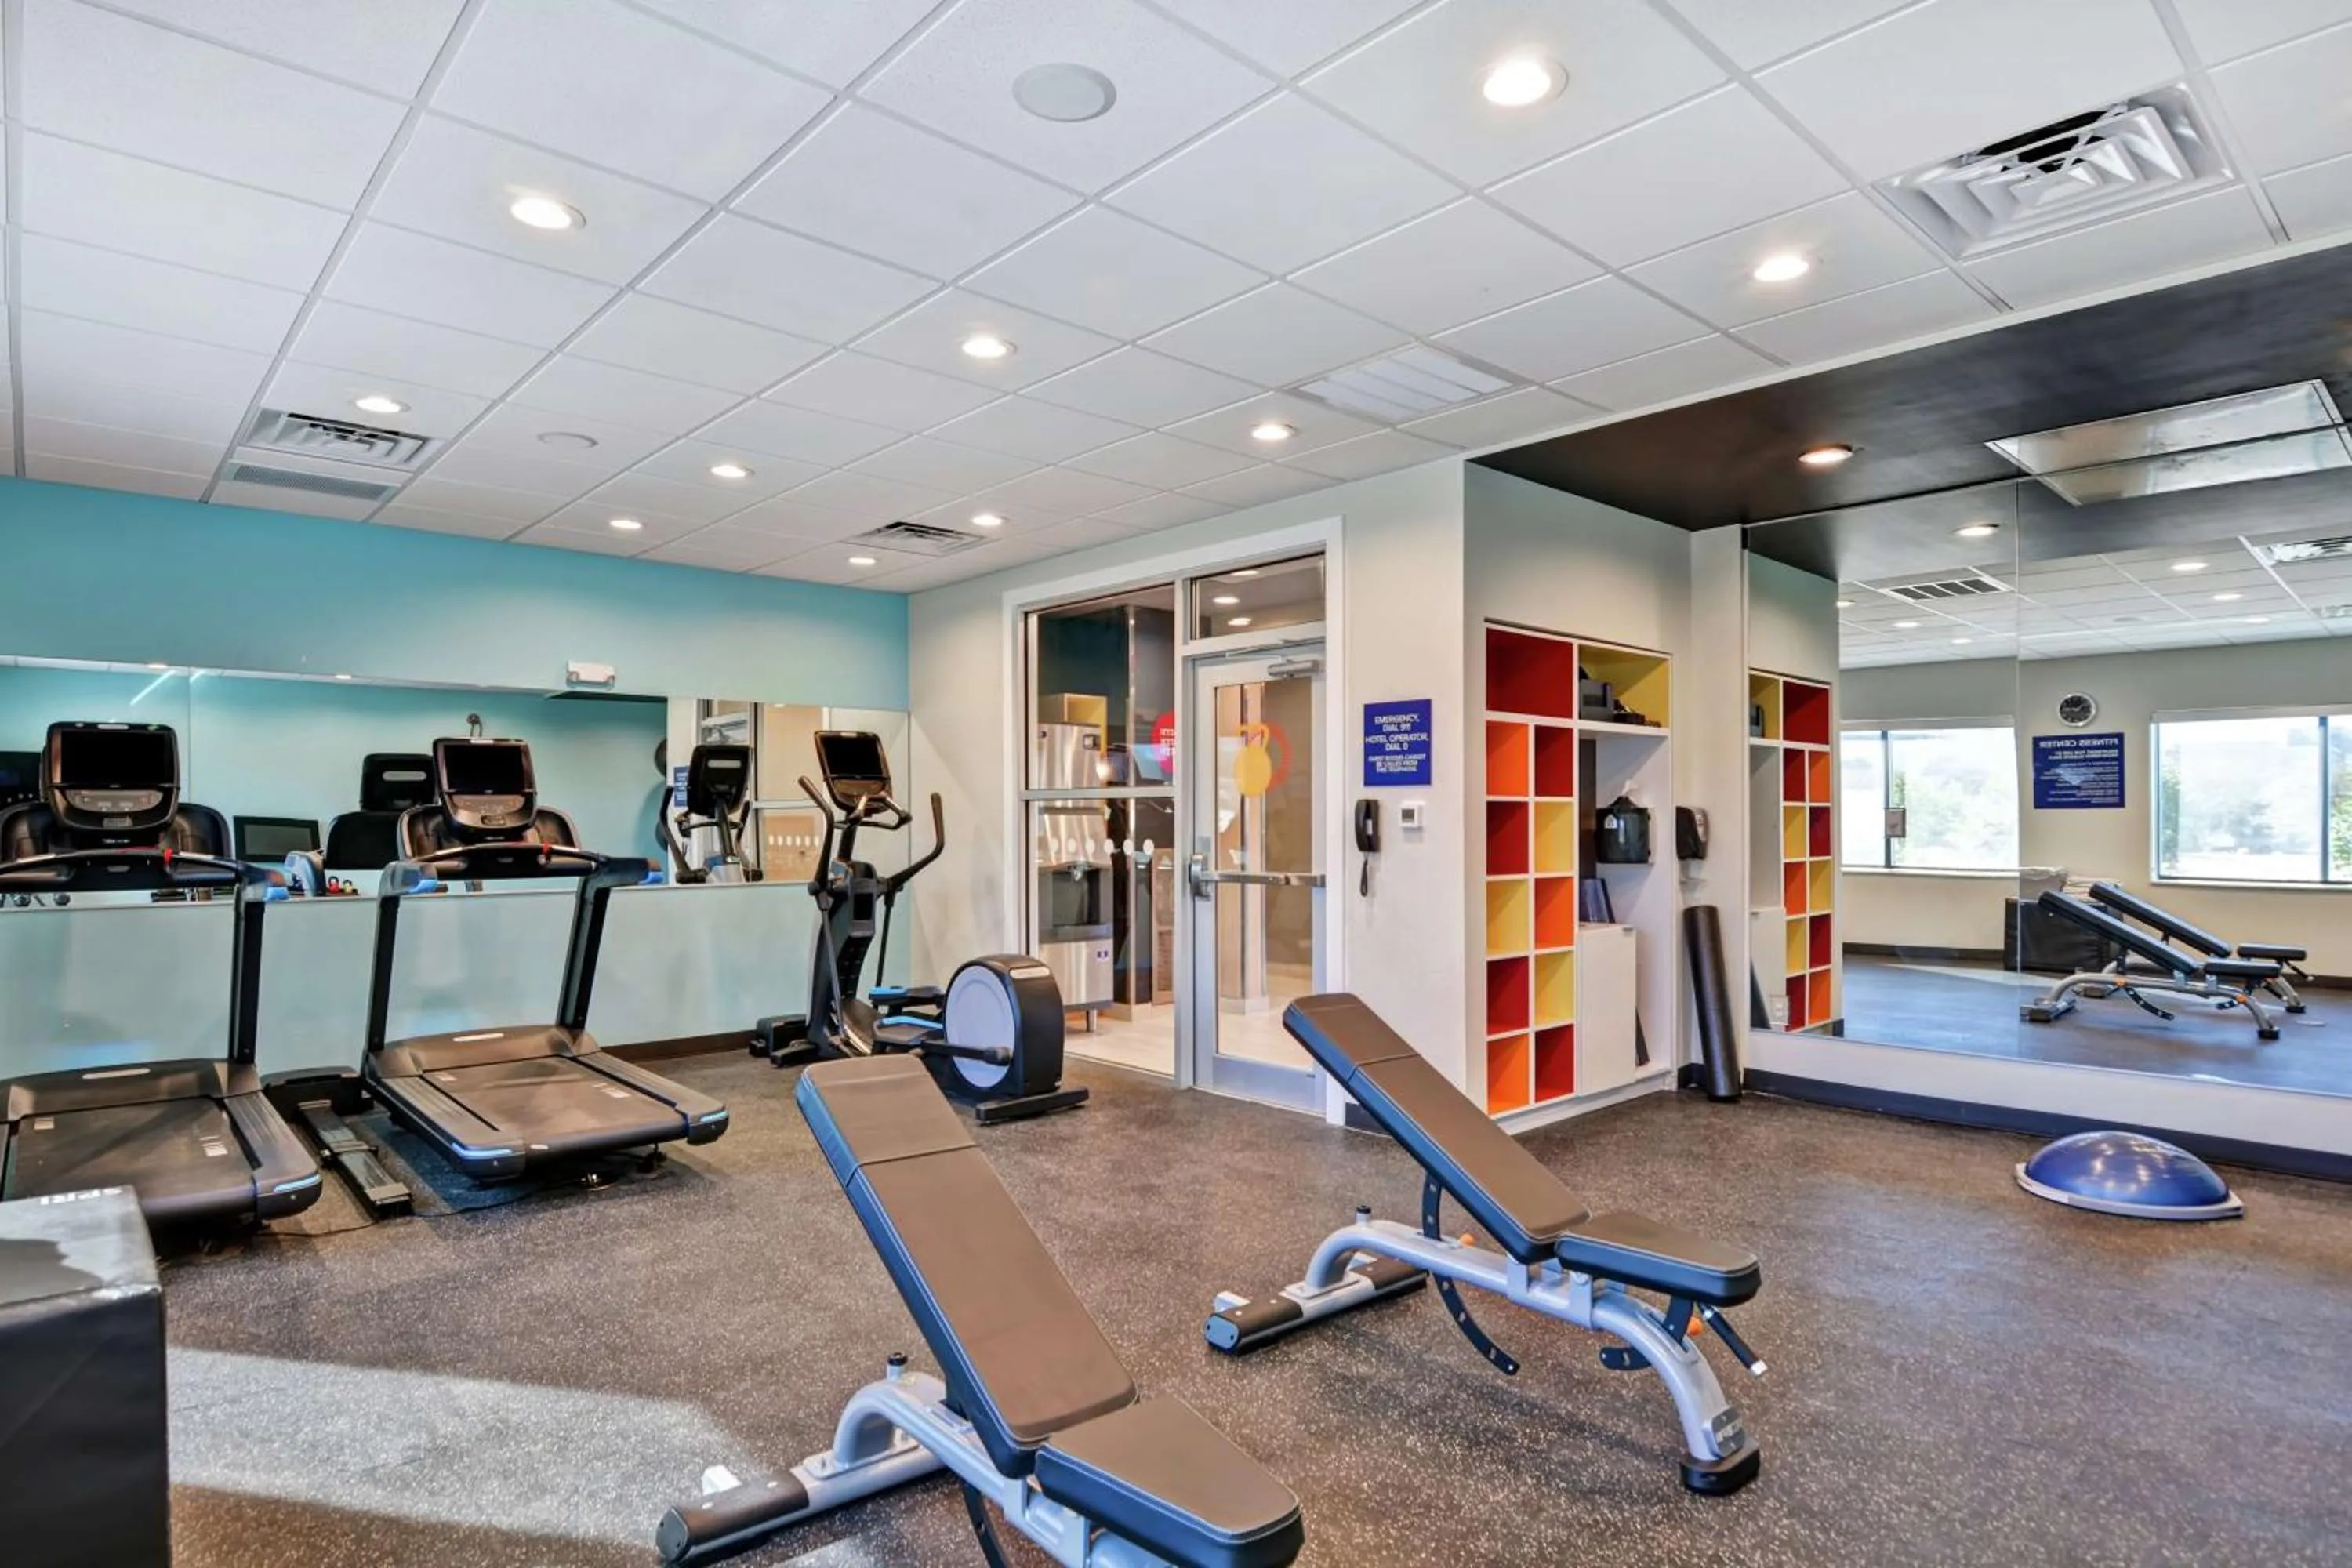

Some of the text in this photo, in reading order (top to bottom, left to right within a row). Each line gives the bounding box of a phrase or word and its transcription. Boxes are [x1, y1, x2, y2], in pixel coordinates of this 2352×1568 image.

[1383, 723, 1411, 732] DIAL 911
[1366, 735, 1388, 743] HOTEL
[1385, 742, 1401, 751] DIAL
